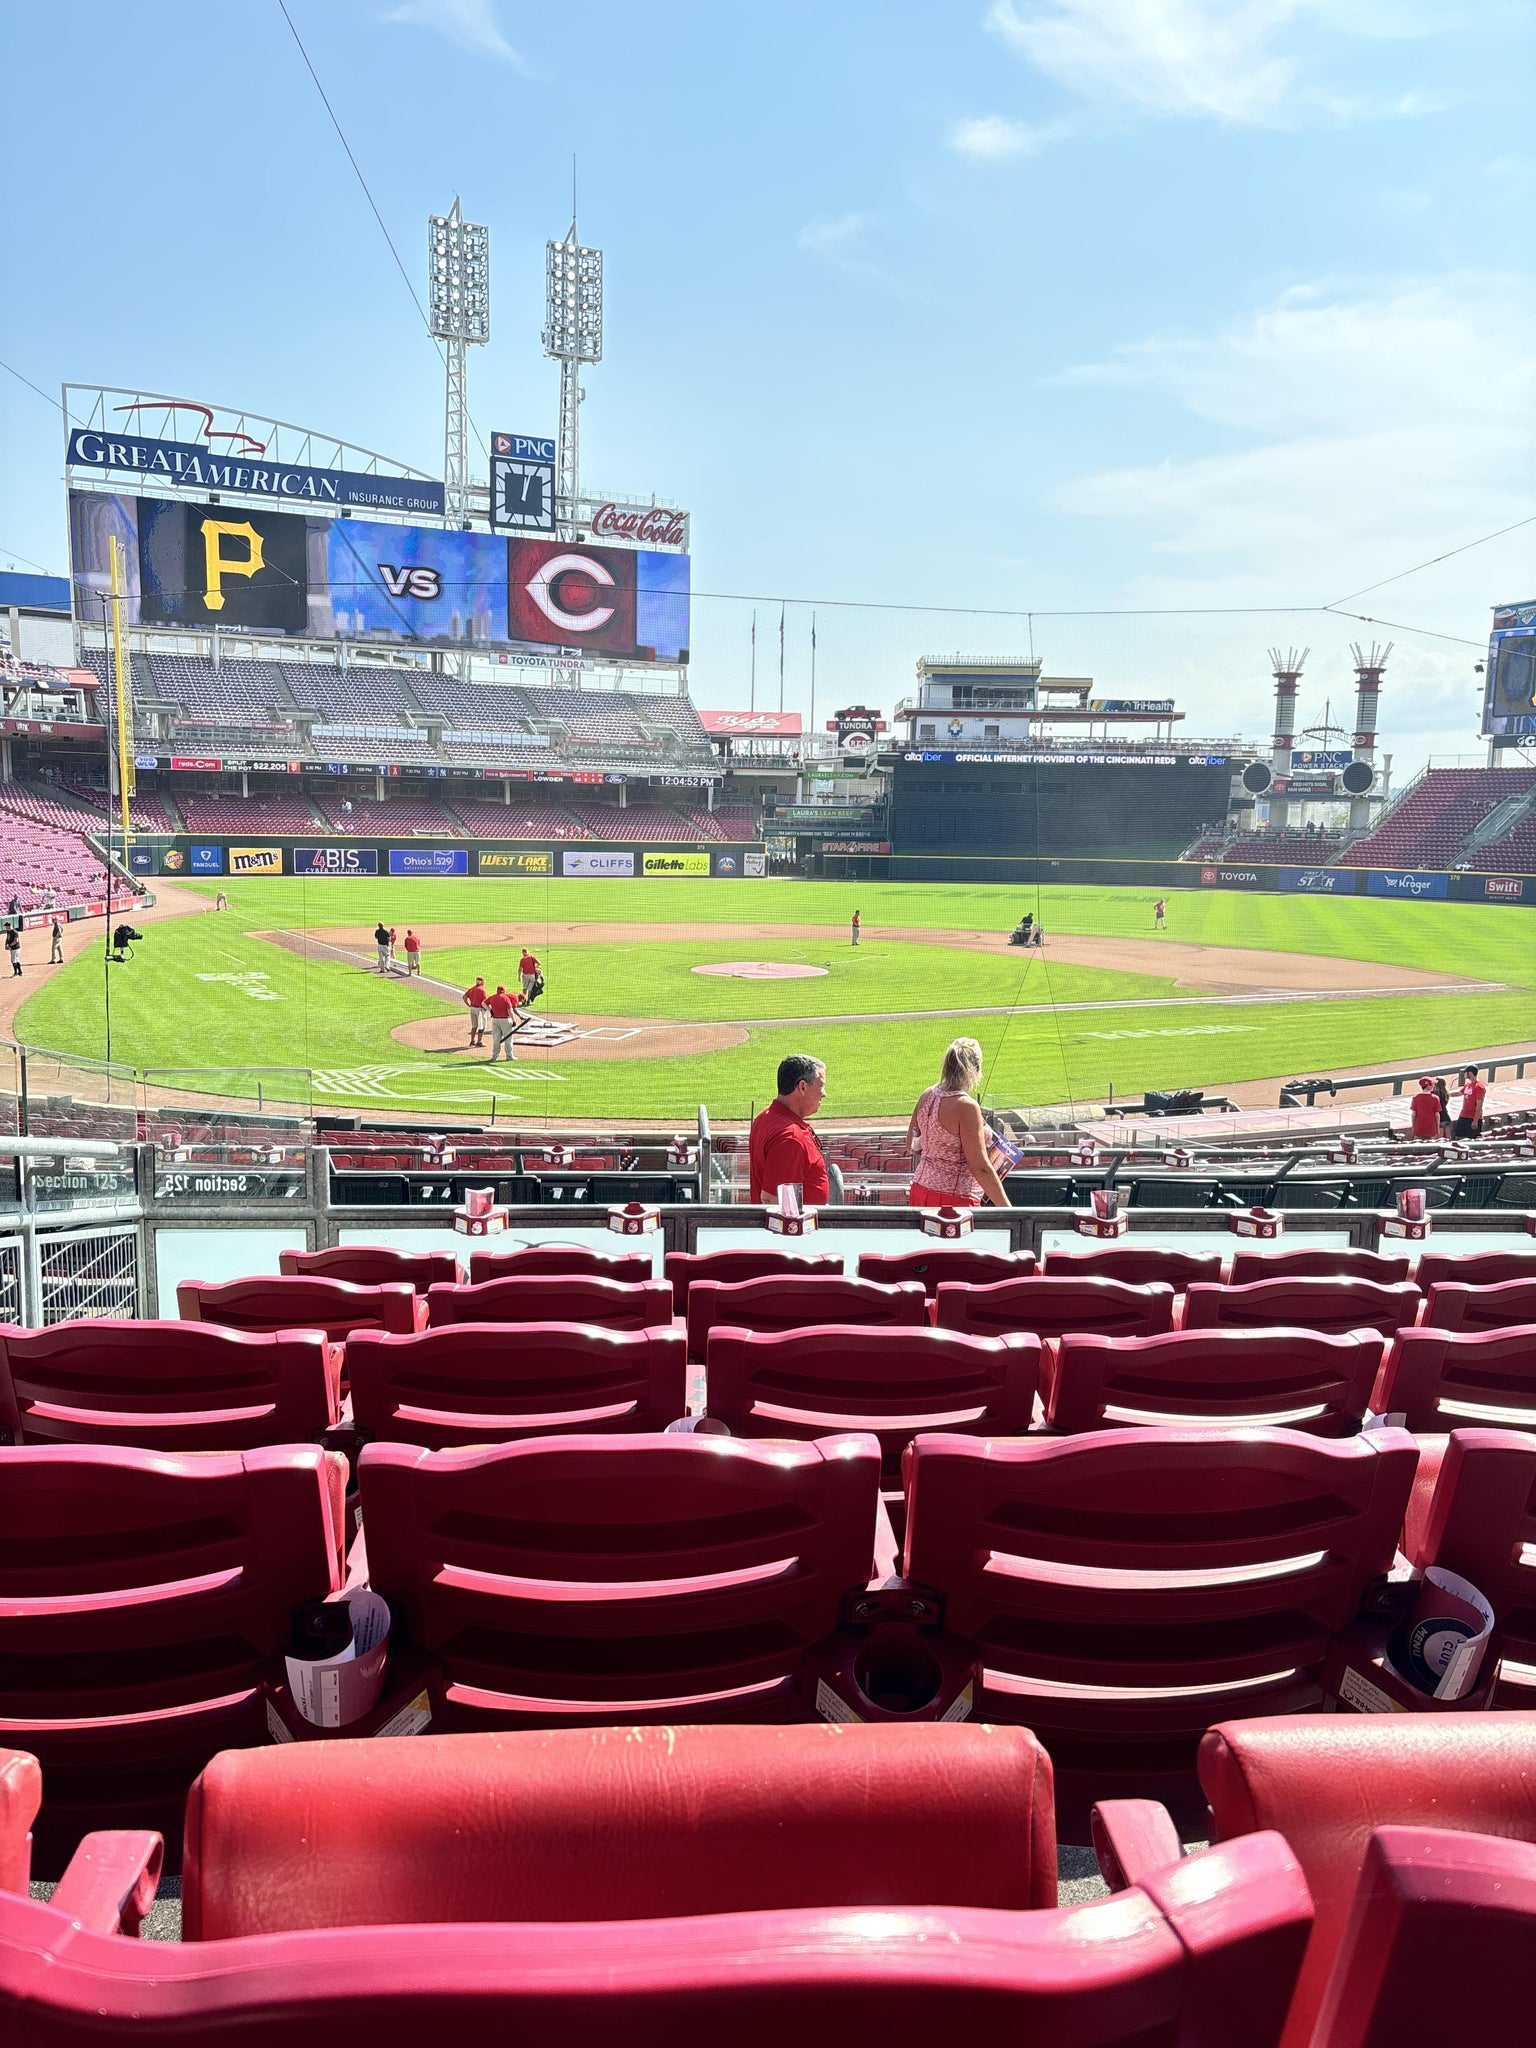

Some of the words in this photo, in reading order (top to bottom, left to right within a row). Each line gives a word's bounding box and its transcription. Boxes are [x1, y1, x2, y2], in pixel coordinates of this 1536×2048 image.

[514, 438, 554, 458] PNC
[348, 491, 404, 508] INSURANCE
[407, 498, 439, 511] GROUP
[592, 503, 688, 545] Coca-Cola
[200, 519, 265, 610] P
[378, 563, 441, 599] VS
[524, 554, 615, 631] C
[511, 656, 546, 667] TOYOTA
[549, 659, 585, 669] TUNDRA
[1133, 701, 1173, 711] TriHealth
[839, 722, 872, 730] TUNDRA
[904, 752, 942, 763] altafiber
[955, 754, 992, 762] OFFICIAL
[993, 754, 1033, 763] INTERNET
[1033, 755, 1075, 763] PROVIDER
[1076, 755, 1088, 764] OF
[1089, 756, 1105, 764] THE
[1105, 756, 1154, 765] CINCINNATI
[1154, 757, 1176, 765] REDS
[1188, 755, 1226, 766] altafiber
[1314, 752, 1342, 763] PNC
[660, 776, 698, 786] 12:04:52
[700, 778, 714, 787] PM
[822, 842, 848, 851] STAR
[312, 849, 359, 869] 4BIS
[403, 856, 433, 866] Ohio's
[436, 857, 453, 866] 529
[481, 855, 515, 866] WEST
[517, 855, 549, 866] LAKE
[590, 859, 633, 868] CLIFFS
[645, 859, 685, 870] Gillette
[685, 858, 708, 871] Labs
[1220, 872, 1257, 881] TOYOTA
[1399, 875, 1431, 895] Kroger
[1488, 881, 1518, 893] Swift
[36, 1175, 88, 1190] Section
[94, 1173, 118, 1191] 125
[1412, 1626, 1429, 1658] MENU
[1438, 1641, 1454, 1667] CLUB
